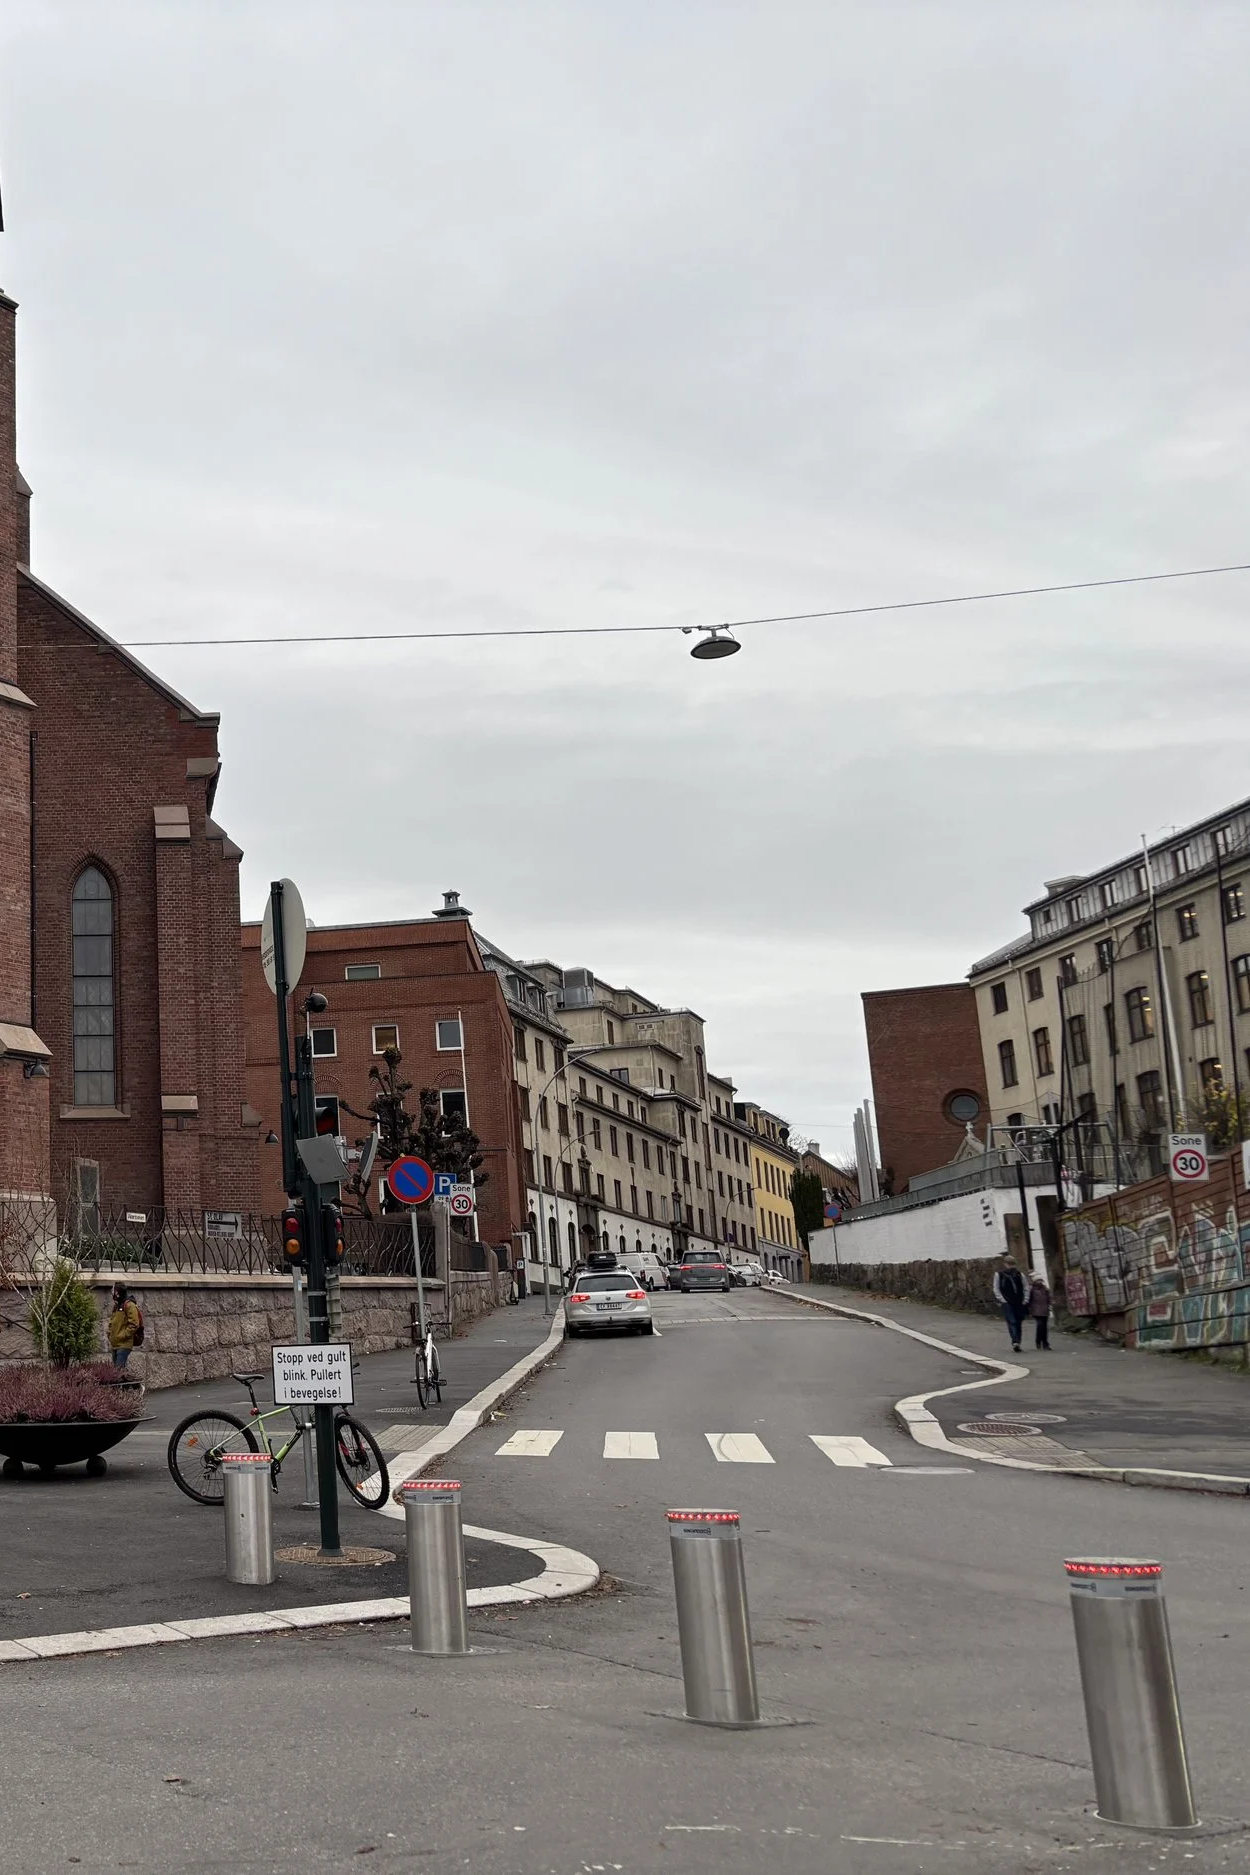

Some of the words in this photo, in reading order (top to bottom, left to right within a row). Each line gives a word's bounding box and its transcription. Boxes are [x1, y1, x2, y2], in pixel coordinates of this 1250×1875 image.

[1171, 1135, 1202, 1145] Sone
[1178, 1156, 1200, 1171] 30
[439, 1176, 450, 1193] P
[455, 1199, 468, 1209] 30
[277, 1352, 303, 1366] Stopp
[307, 1350, 323, 1362] ved
[327, 1350, 346, 1365] gult
[283, 1369, 308, 1381] blink.
[310, 1369, 342, 1380] Pullert
[284, 1387, 287, 1398] i
[290, 1386, 342, 1401] bevegelse!
